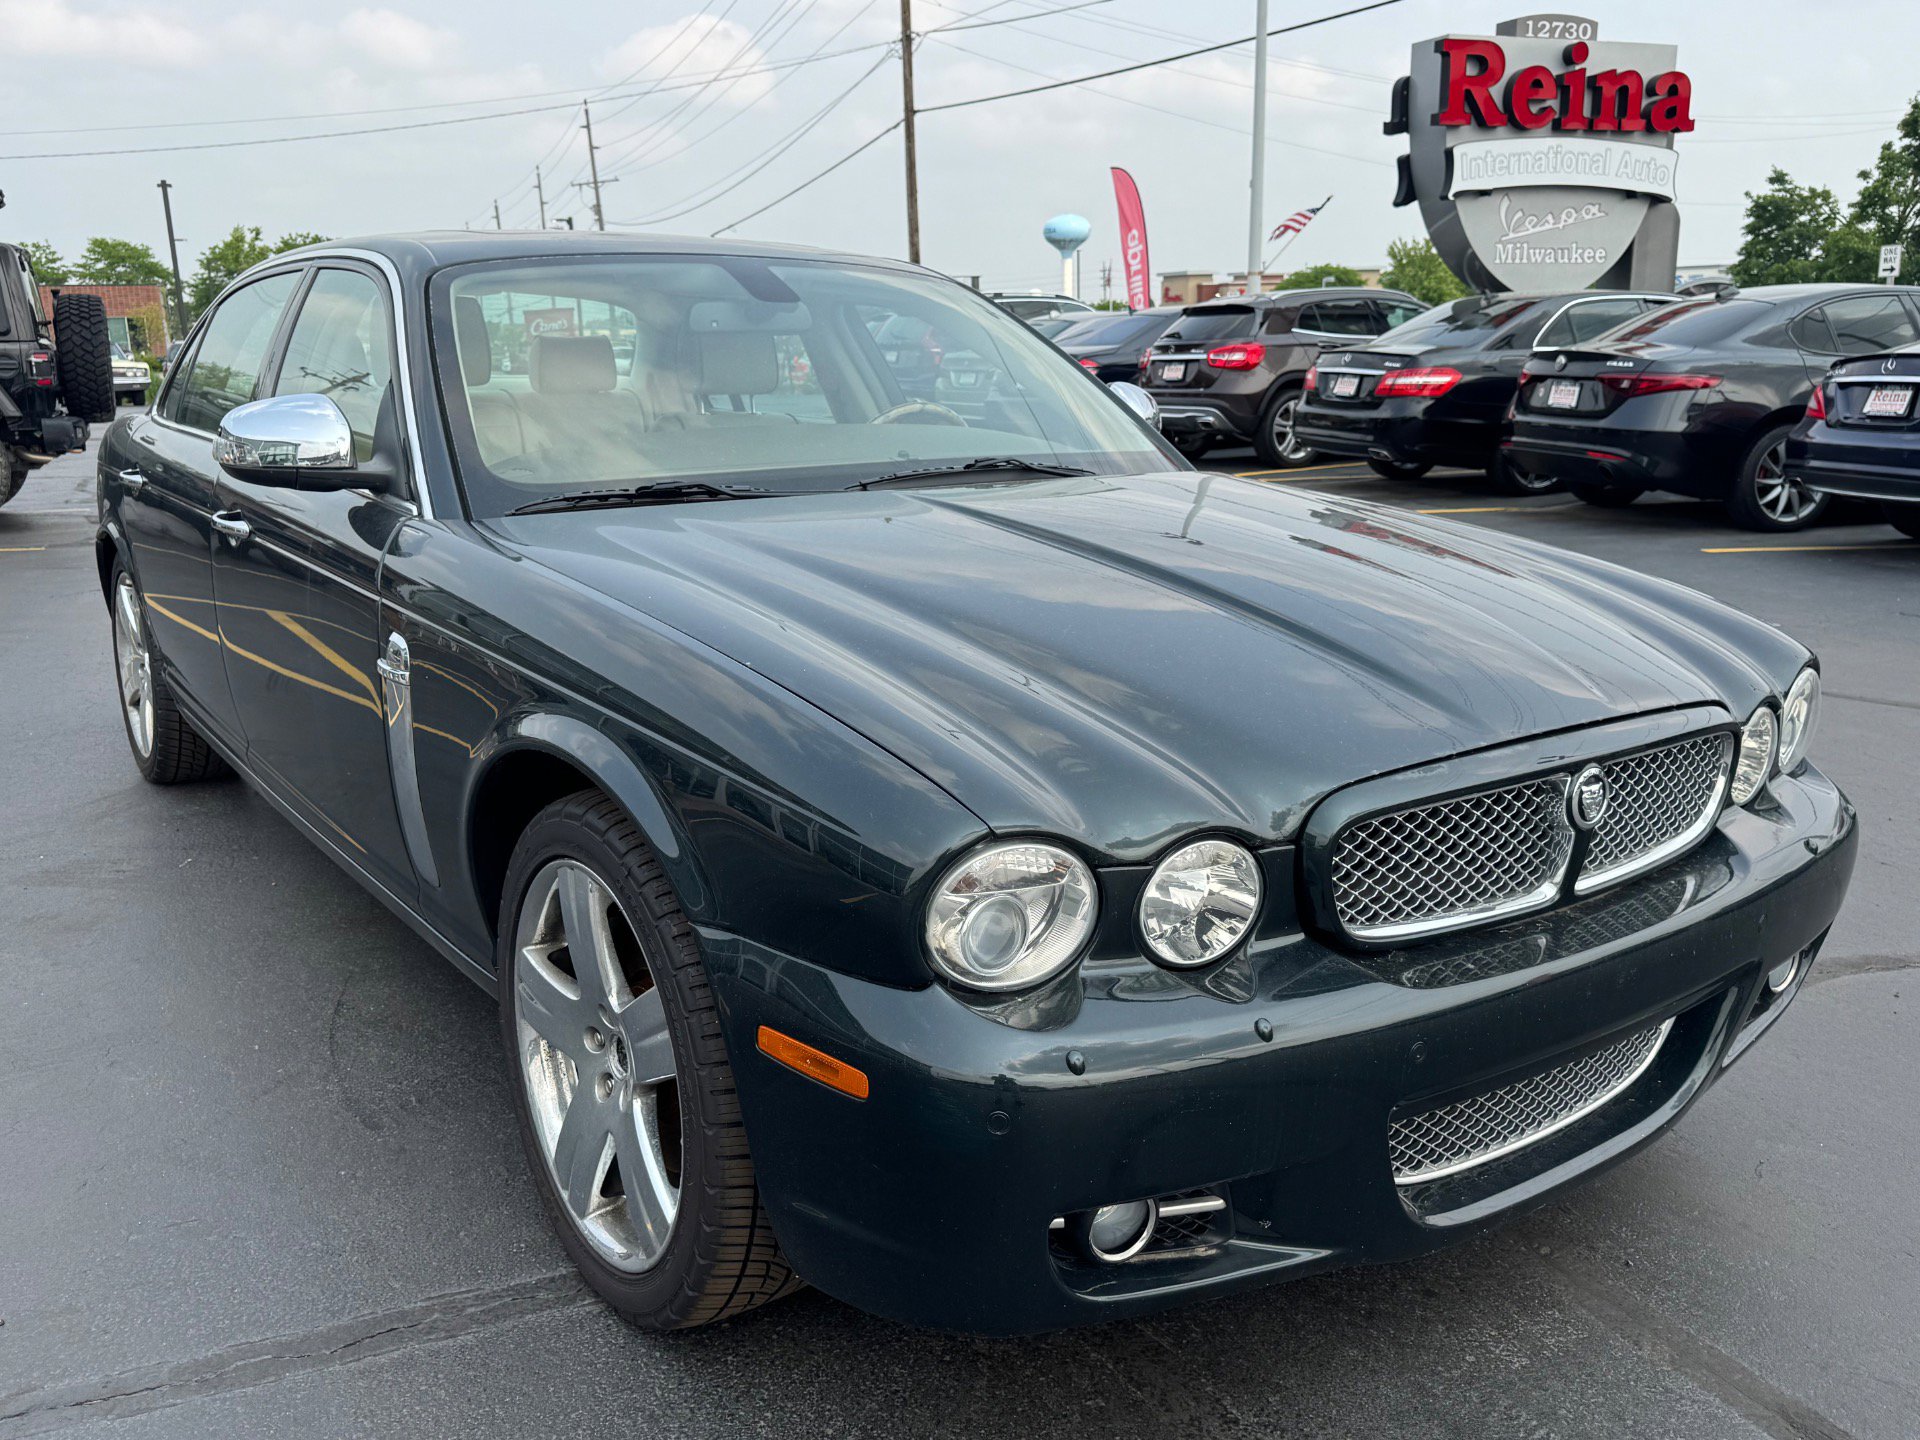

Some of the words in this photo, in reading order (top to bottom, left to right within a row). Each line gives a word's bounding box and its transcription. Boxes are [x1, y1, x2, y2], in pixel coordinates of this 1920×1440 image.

[1524, 20, 1592, 40] 12730
[1433, 38, 1695, 133] Reina
[1460, 146, 1609, 181] International
[1615, 152, 1670, 186] Auto
[1500, 193, 1608, 241] Vespa
[1494, 243, 1607, 264] Milwaukee
[1883, 247, 1898, 255] ONE
[1883, 256, 1897, 264] WAY
[1872, 390, 1908, 402] Reina
